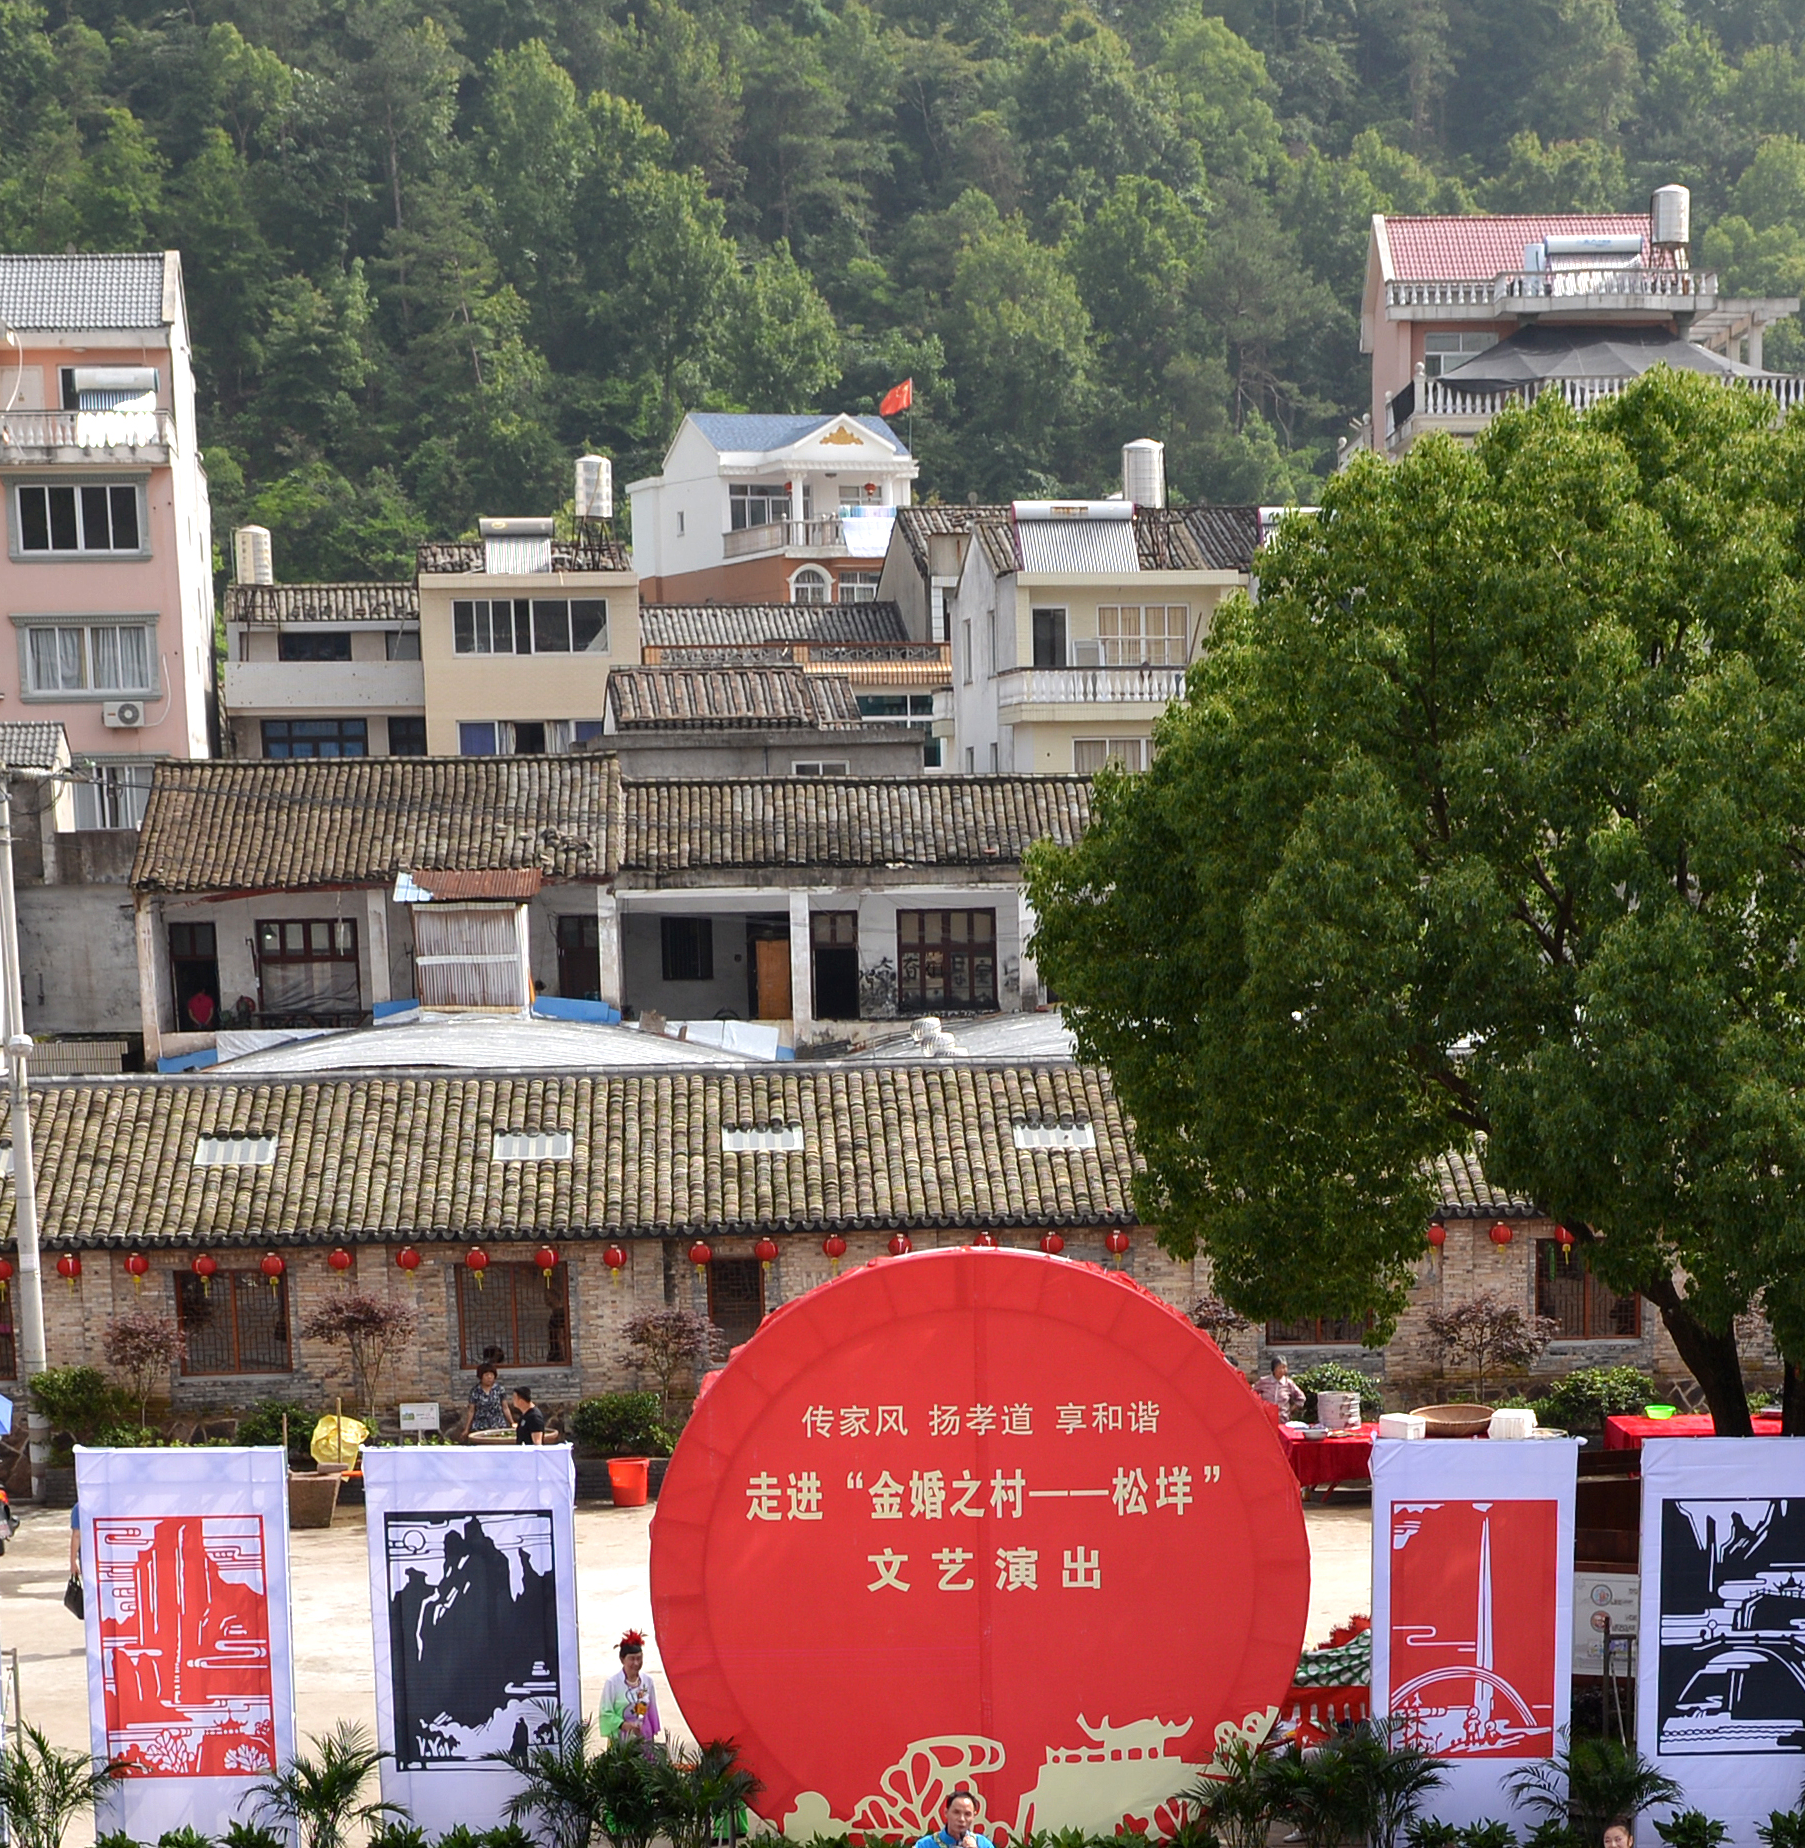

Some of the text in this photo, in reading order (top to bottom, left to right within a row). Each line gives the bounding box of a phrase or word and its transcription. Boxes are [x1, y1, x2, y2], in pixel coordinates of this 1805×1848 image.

[801, 1401, 1161, 1439] 传家风 扬孝道 享和谐
[867, 1546, 1103, 1592] 文艺演出
